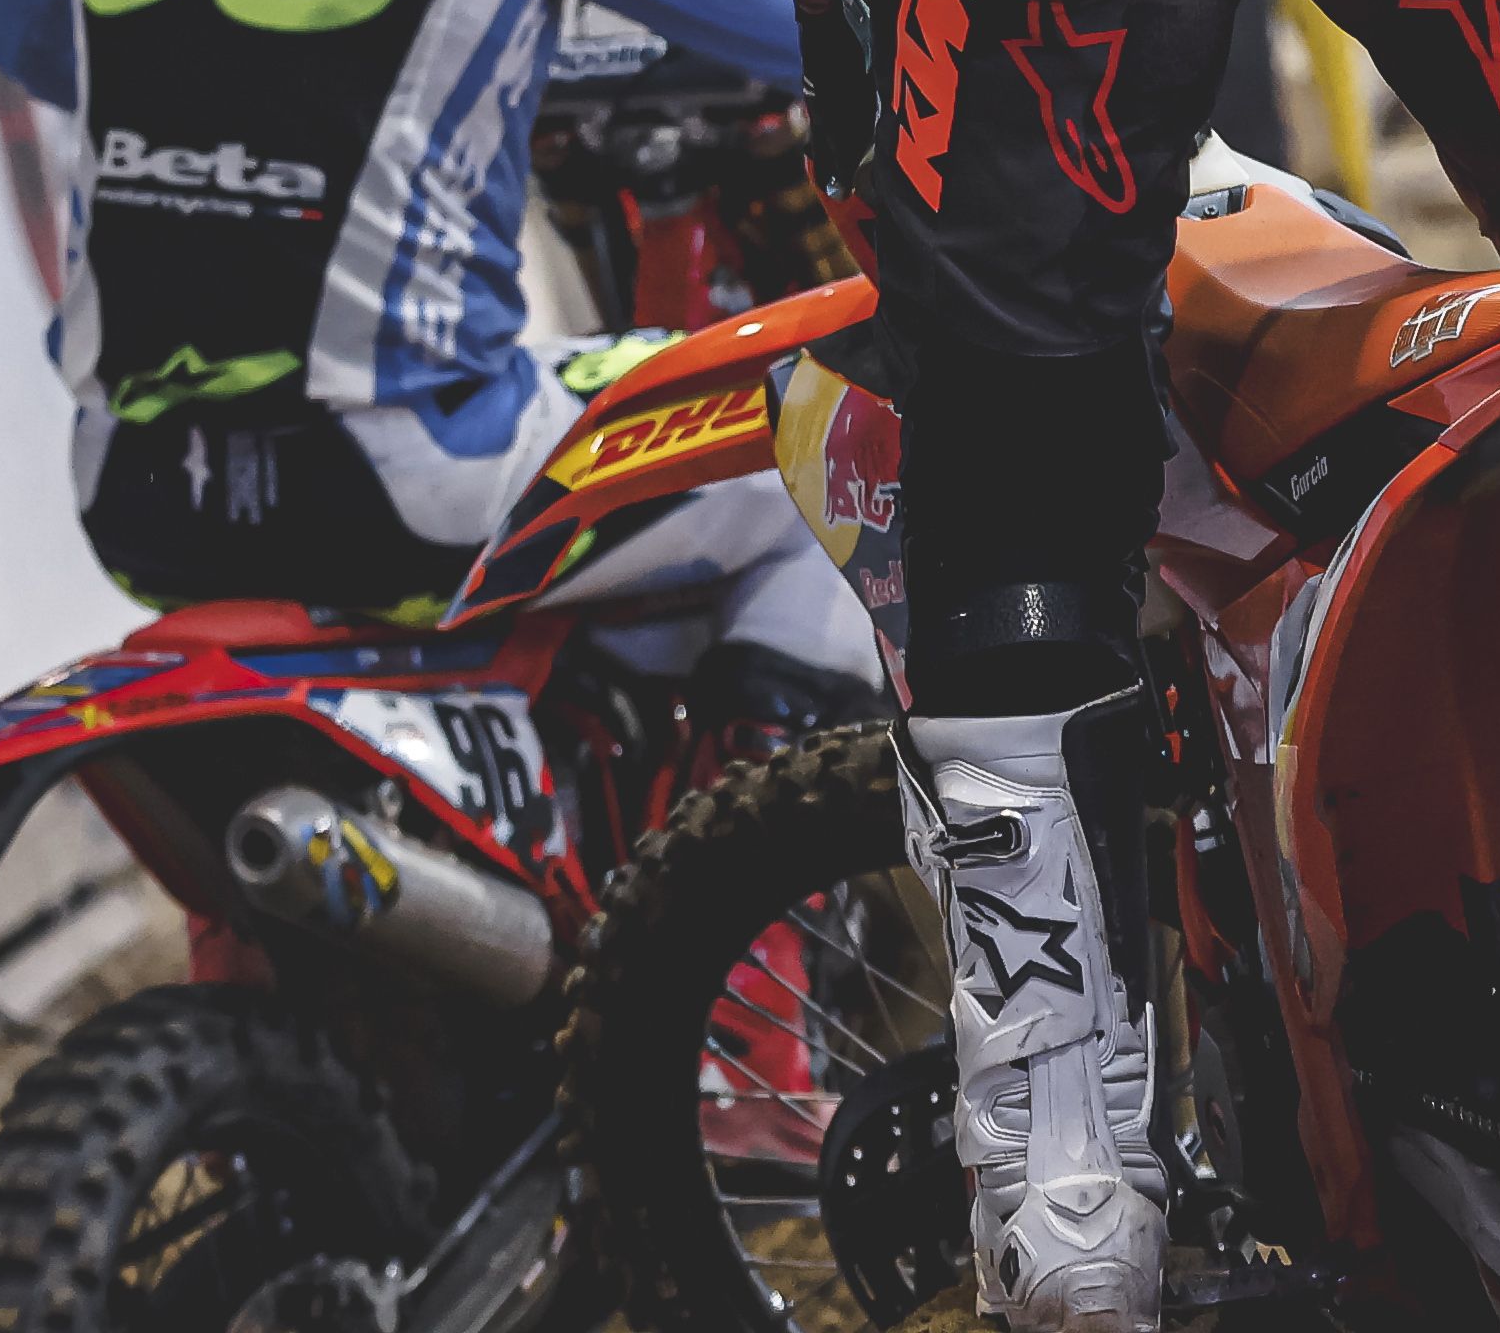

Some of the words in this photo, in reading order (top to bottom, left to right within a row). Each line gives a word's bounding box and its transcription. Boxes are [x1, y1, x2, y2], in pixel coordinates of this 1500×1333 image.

[98, 128, 327, 200] Beta
[590, 387, 768, 475] DHL
[436, 703, 550, 827] 96
